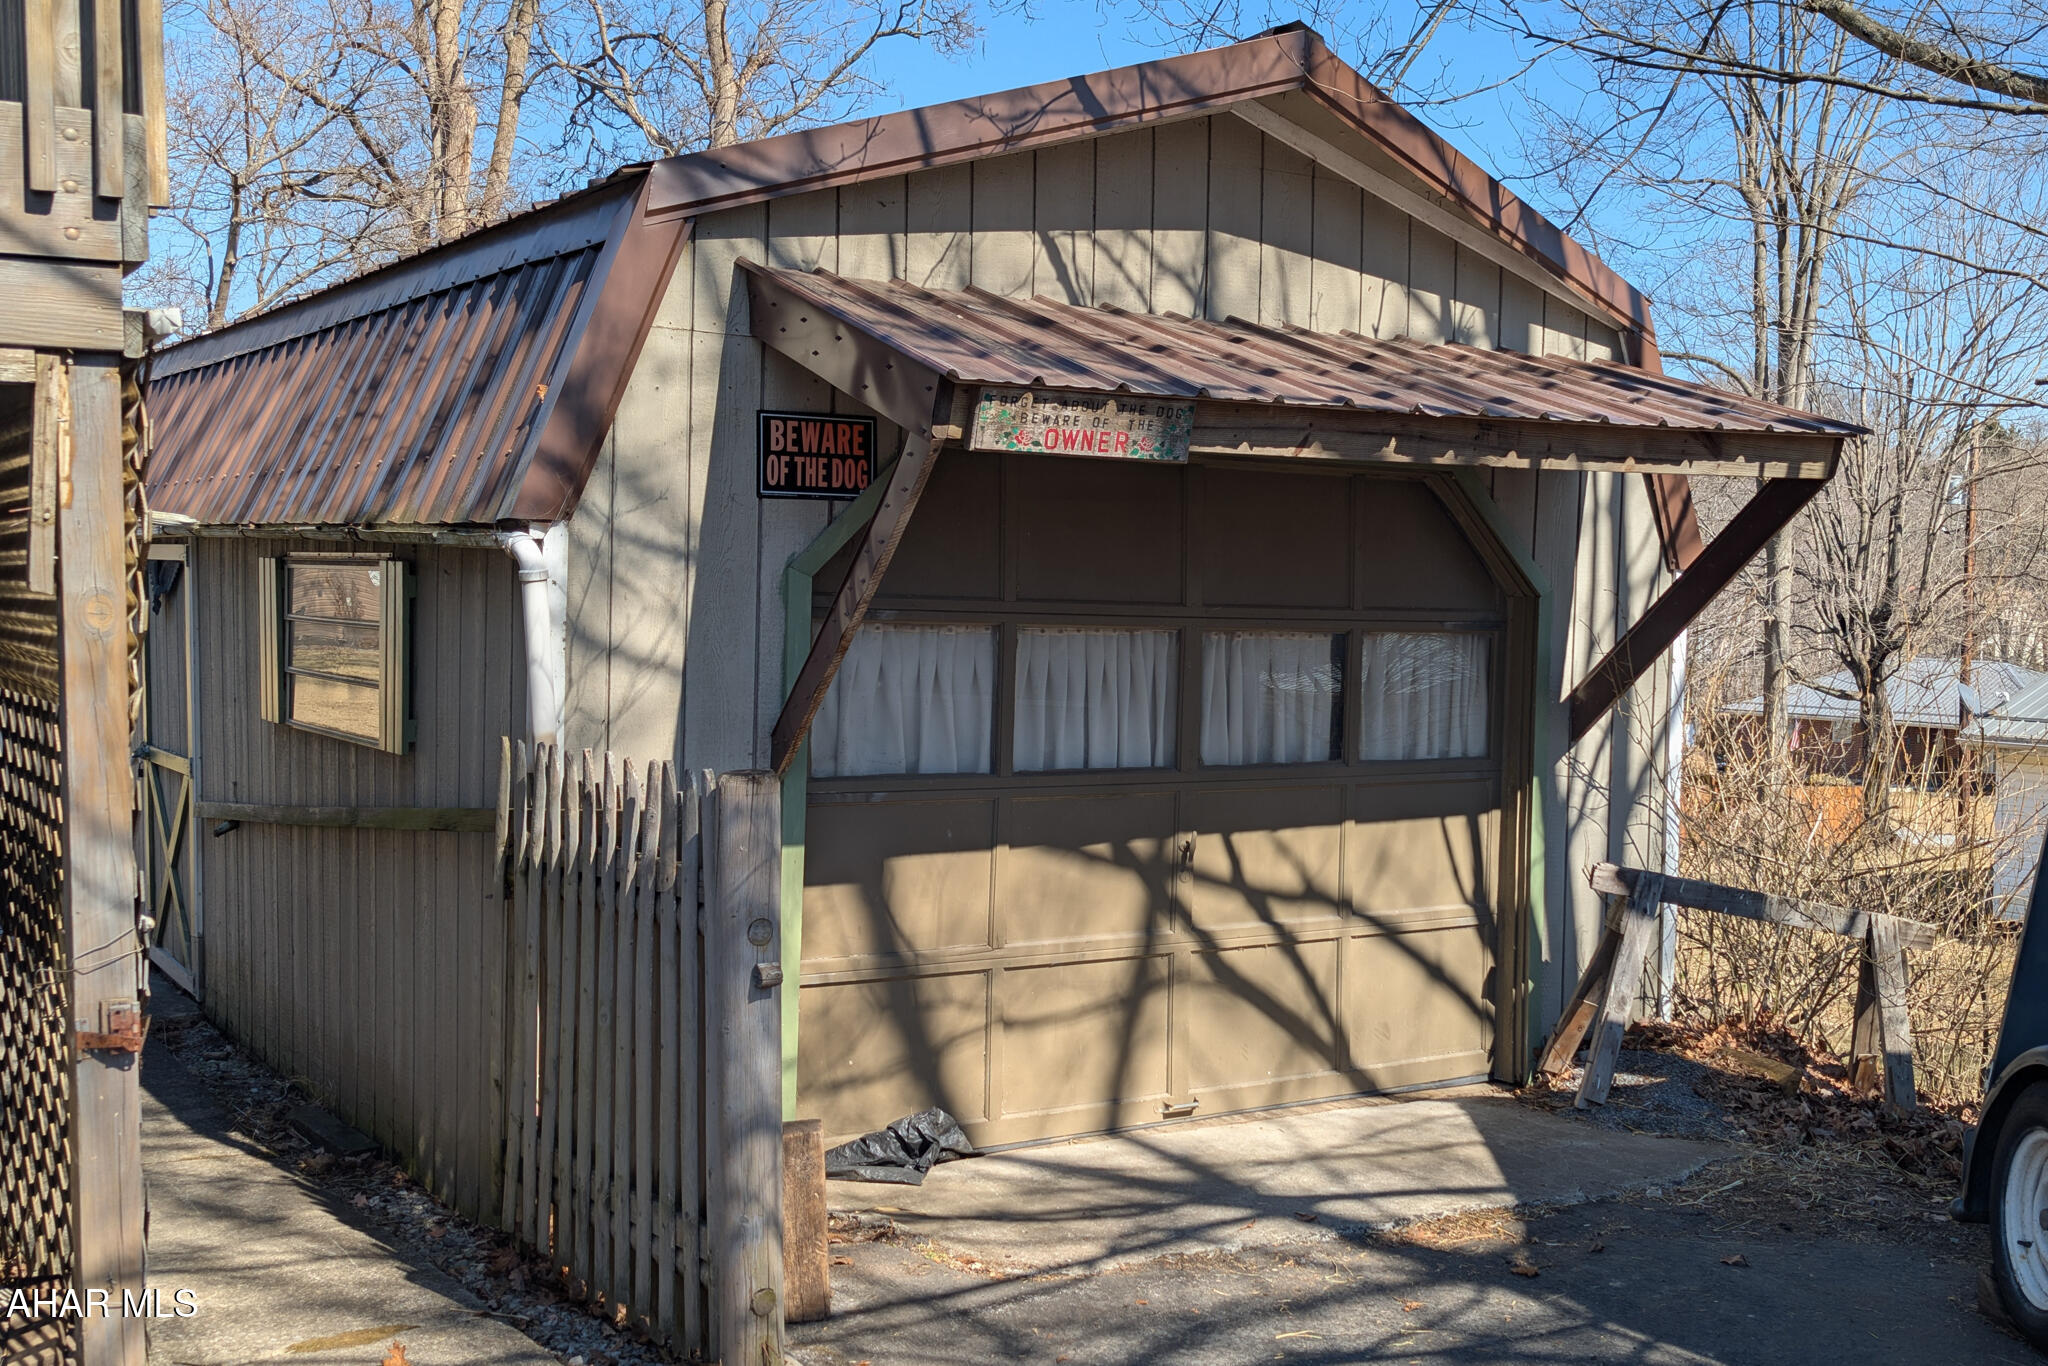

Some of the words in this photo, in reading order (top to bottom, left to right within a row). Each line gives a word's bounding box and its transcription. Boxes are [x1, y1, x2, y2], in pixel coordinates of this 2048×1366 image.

[989, 394, 1048, 409] FORGET
[1061, 398, 1109, 413] ABOUT
[1120, 403, 1145, 416] THE
[1156, 405, 1183, 419] DOG
[1019, 412, 1081, 427] BEWARE
[1092, 416, 1110, 429] OF
[1129, 418, 1154, 432] THE
[770, 419, 865, 456] BEWARE
[1043, 427, 1130, 453] OWNER
[766, 454, 790, 486] OF
[794, 456, 828, 488] THE
[832, 457, 868, 490] DOG
